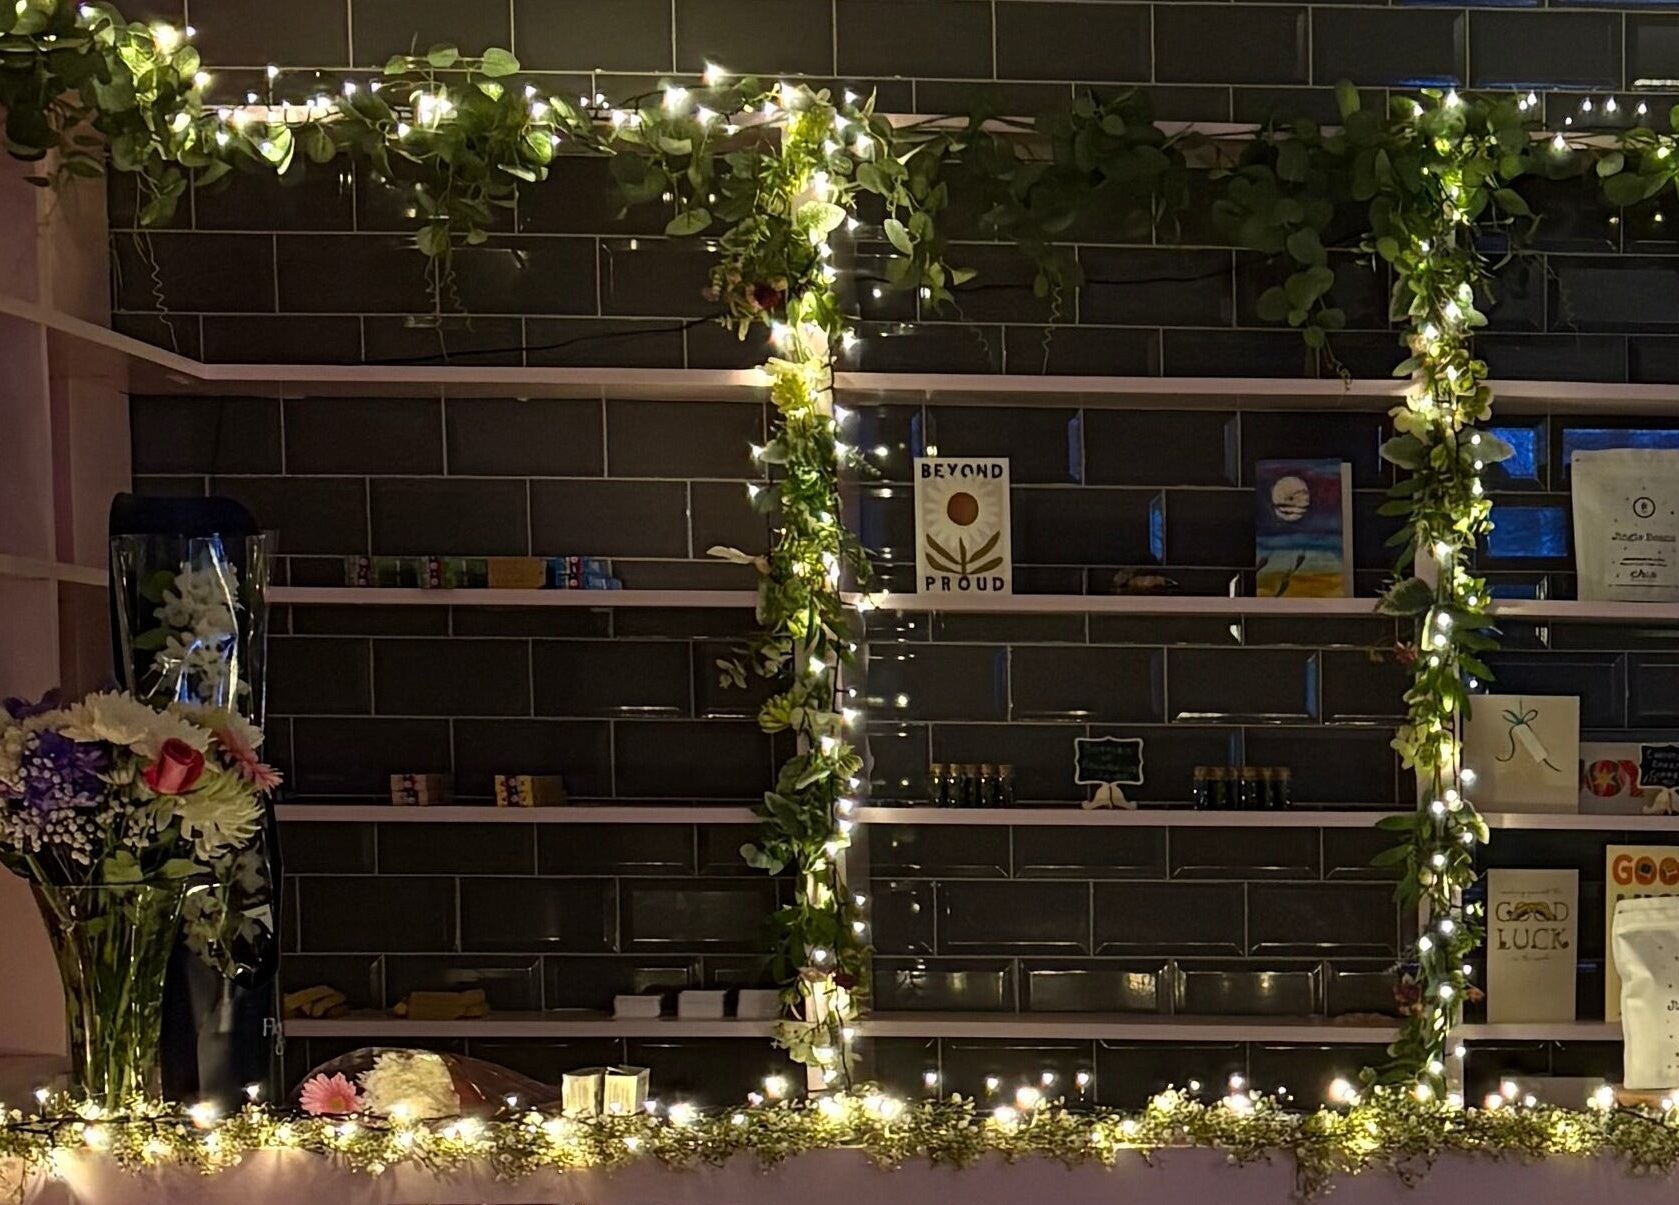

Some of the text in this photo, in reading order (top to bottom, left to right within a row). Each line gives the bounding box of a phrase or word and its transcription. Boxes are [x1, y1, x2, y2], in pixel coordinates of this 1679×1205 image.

[920, 463, 1004, 480] BEYOND
[925, 574, 1005, 592] PROUD
[1495, 901, 1570, 923] GOOD
[1497, 927, 1570, 950] LUCK
